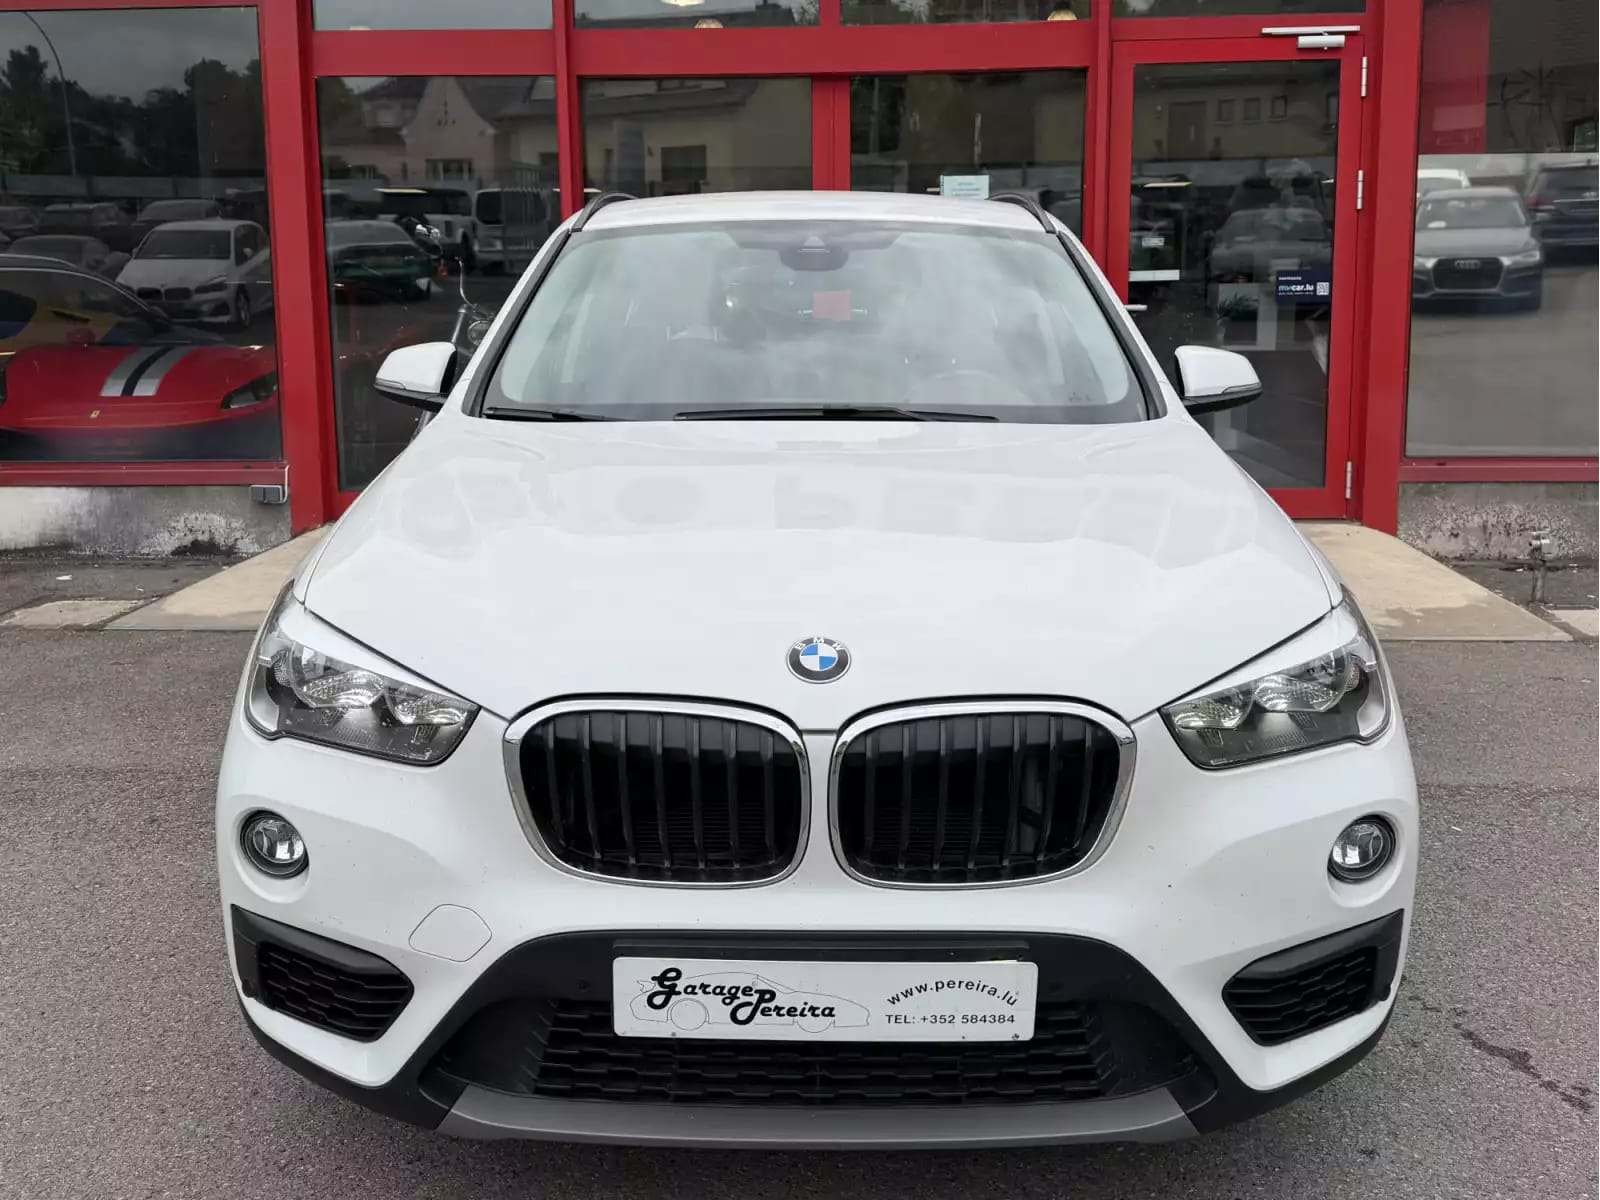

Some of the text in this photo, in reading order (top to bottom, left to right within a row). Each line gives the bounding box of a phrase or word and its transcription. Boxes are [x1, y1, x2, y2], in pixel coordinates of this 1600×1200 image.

[793, 637, 847, 650] BMW
[646, 967, 756, 1010] Garage
[887, 979, 1018, 1006] www.pereira.lu
[729, 988, 836, 1026] Pereira
[885, 1013, 1016, 1025] TEL: +352 584384
